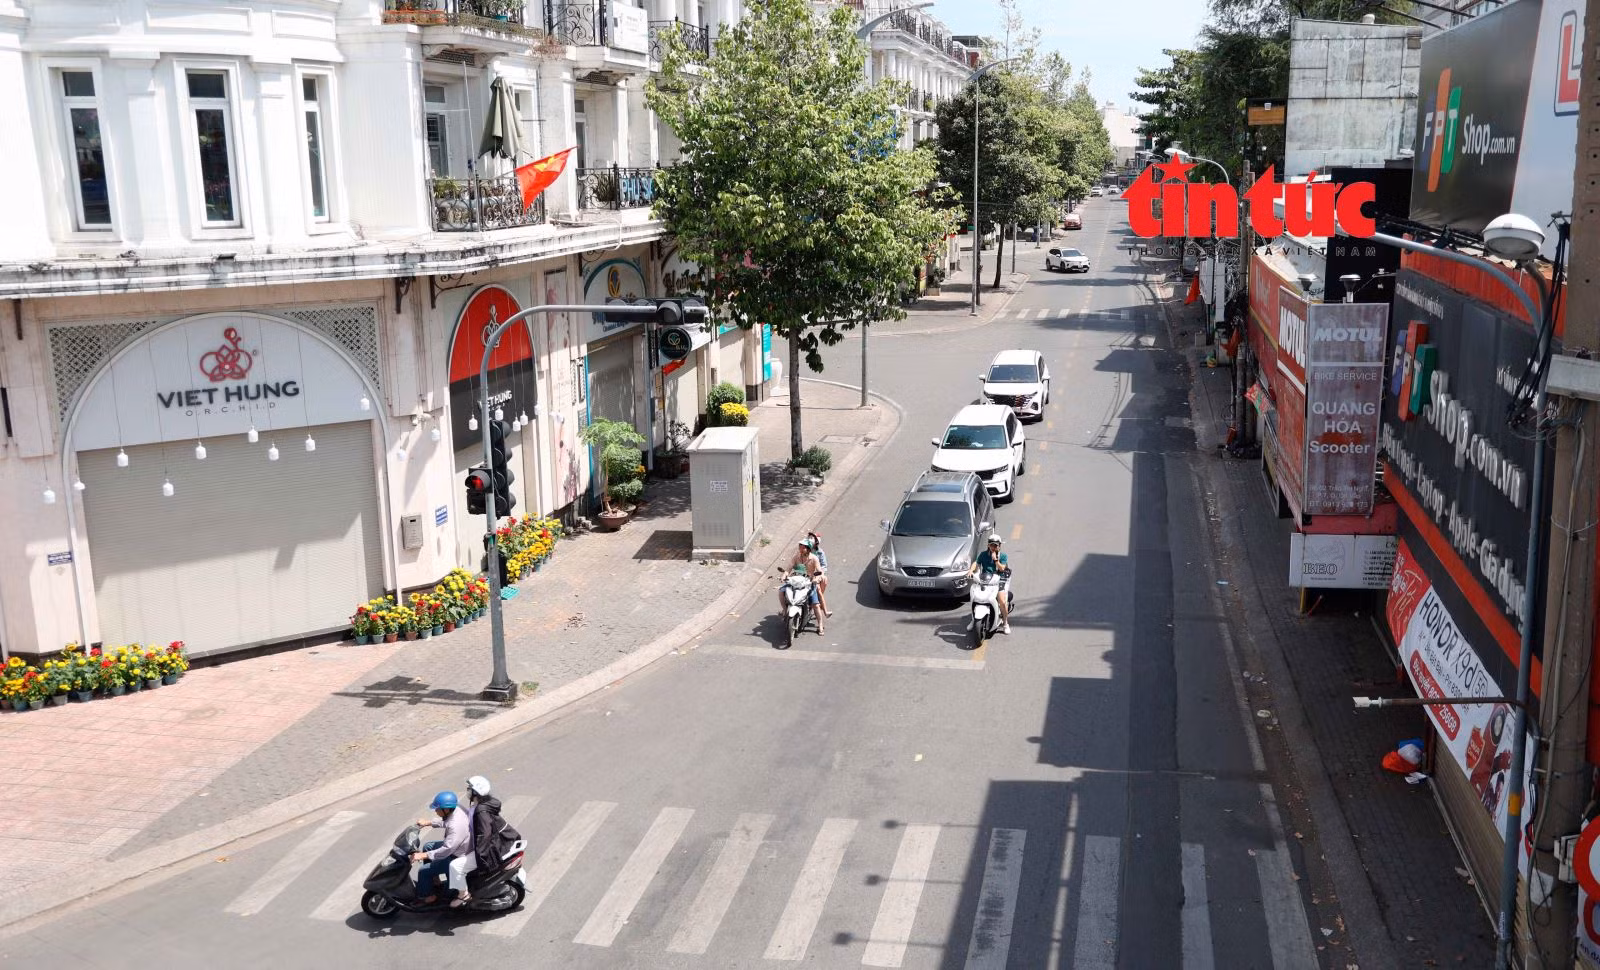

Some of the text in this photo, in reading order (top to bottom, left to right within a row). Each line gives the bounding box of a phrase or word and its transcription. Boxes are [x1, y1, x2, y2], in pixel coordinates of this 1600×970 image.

[1422, 109, 1515, 165] FPT Shop.com.vn
[1279, 306, 1305, 369] MOTUL
[1314, 328, 1383, 341] MOTUL
[1315, 372, 1377, 381] BIKE SERVICE
[1393, 345, 1422, 396] FPT
[157, 381, 299, 409] VIET HUNG
[1312, 401, 1375, 415] QUANG
[1310, 440, 1371, 454] Scooter
[1420, 592, 1459, 662] HONOR
